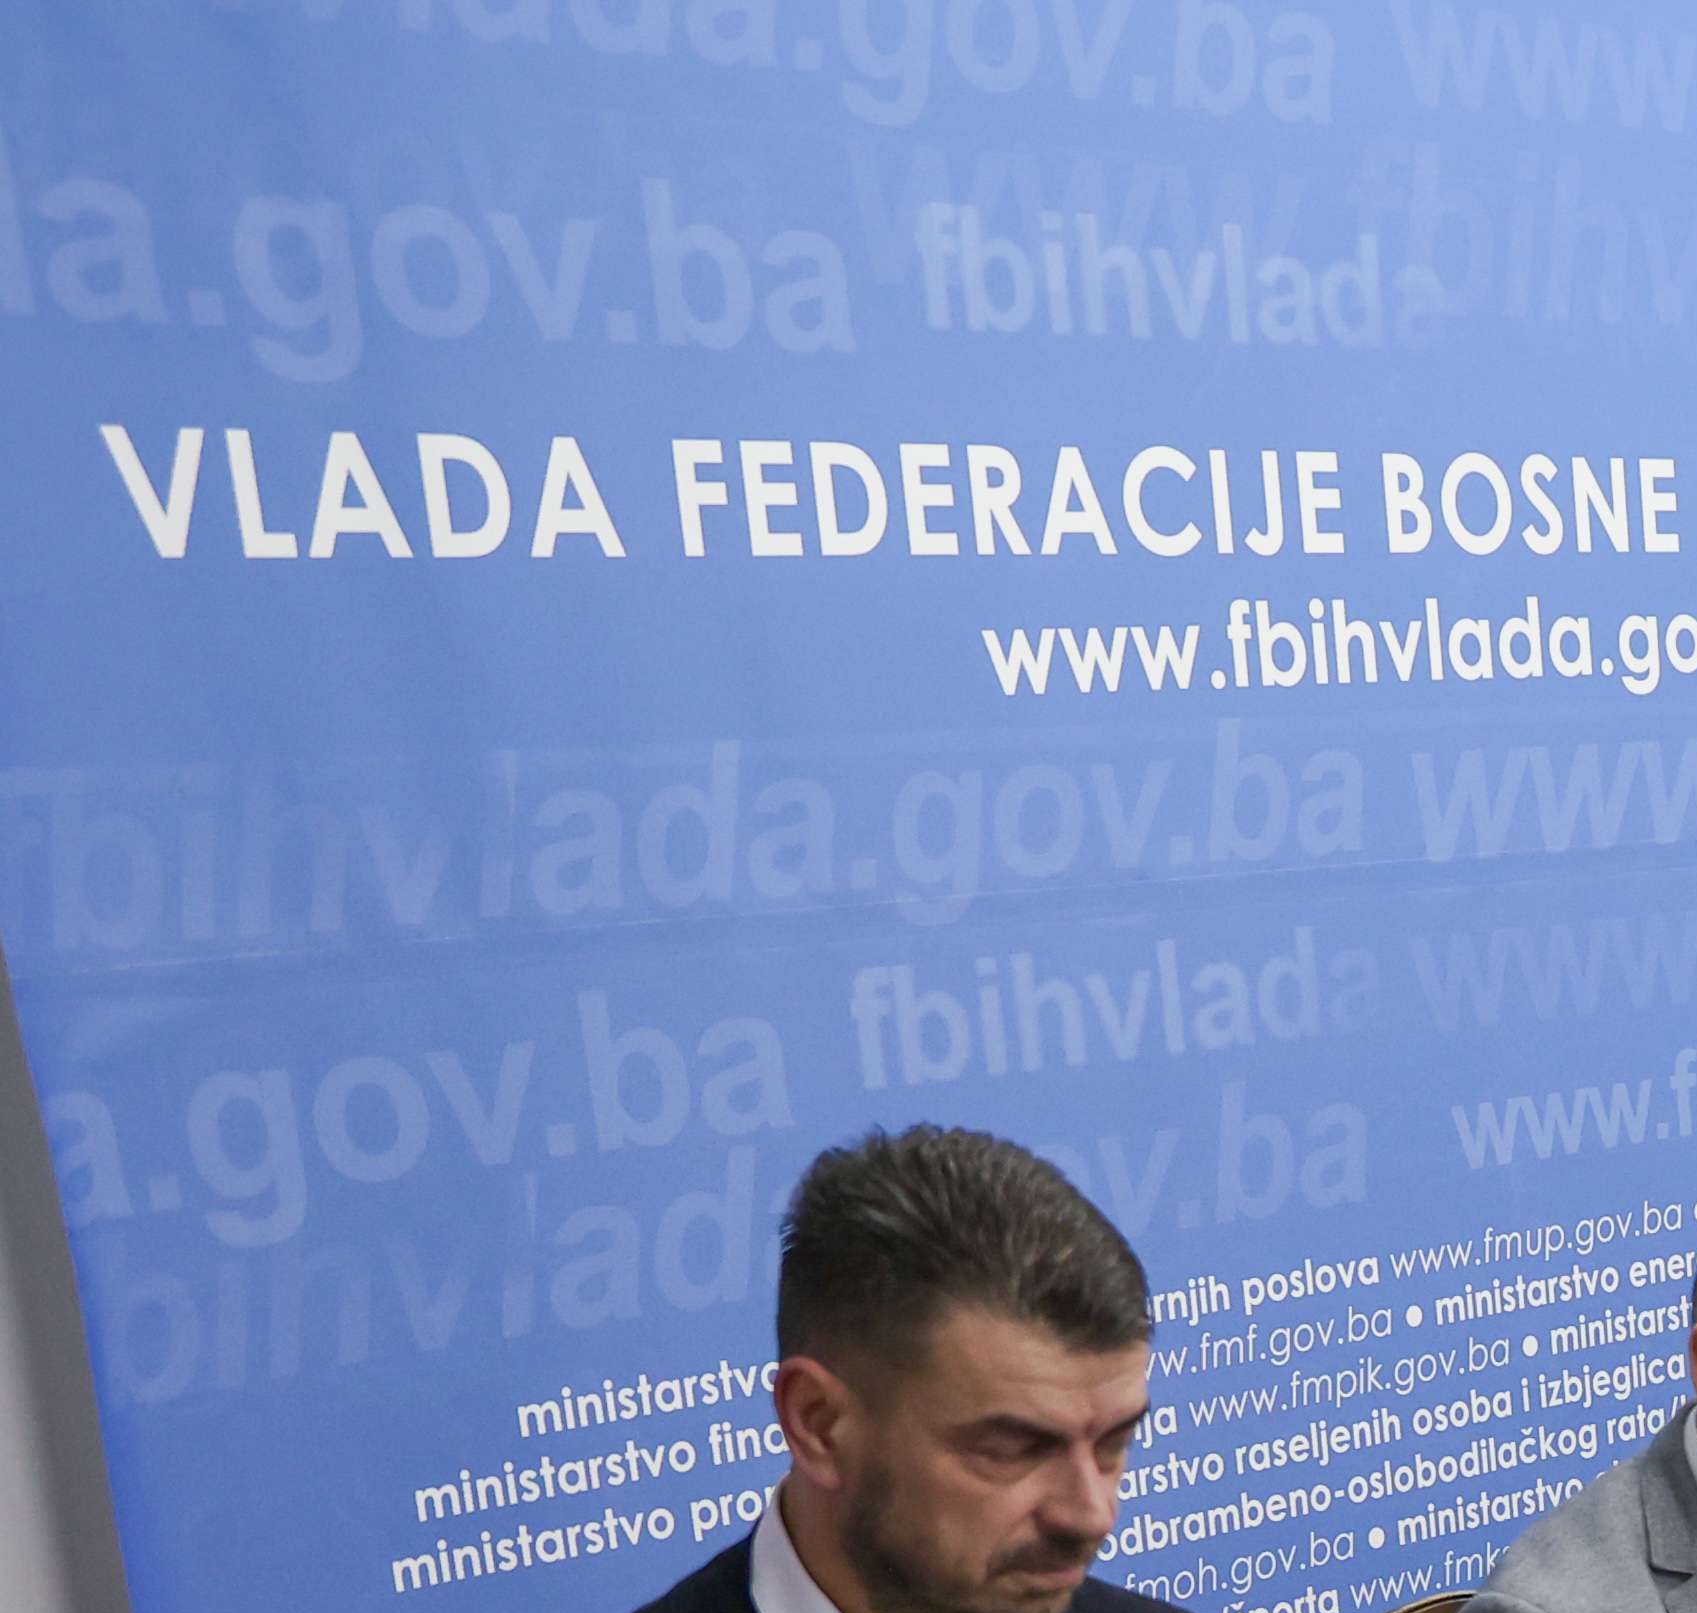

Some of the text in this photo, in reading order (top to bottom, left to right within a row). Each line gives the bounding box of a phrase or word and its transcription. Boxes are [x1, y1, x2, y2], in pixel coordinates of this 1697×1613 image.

[99, 423, 626, 559] VLADA
[671, 438, 1346, 558] FEDERACIJE
[1382, 452, 1681, 556] BOSNE
[517, 1359, 780, 1438] ministarstvo
[1147, 1275, 1232, 1327] rnjih
[1241, 1254, 1379, 1307] poslova
[1389, 1200, 1683, 1279] www.fmup.gov.ba
[392, 1508, 675, 1593] ministarstvo
[1189, 1334, 1511, 1428] www.fmpik.gov.ba
[1550, 1295, 1694, 1356] ministarst
[415, 1438, 697, 1522] ministarstvo
[1434, 1263, 1619, 1326] ministarstvo
[1235, 1407, 1401, 1478] raseljenih
[1413, 1388, 1512, 1436] osoba
[1521, 1378, 1532, 1414] i
[1539, 1353, 1687, 1410] izbjeglica
[1097, 1424, 1598, 1562] odbrambeno-oslobodilačkog
[1396, 1477, 1583, 1547] ministarstvo
